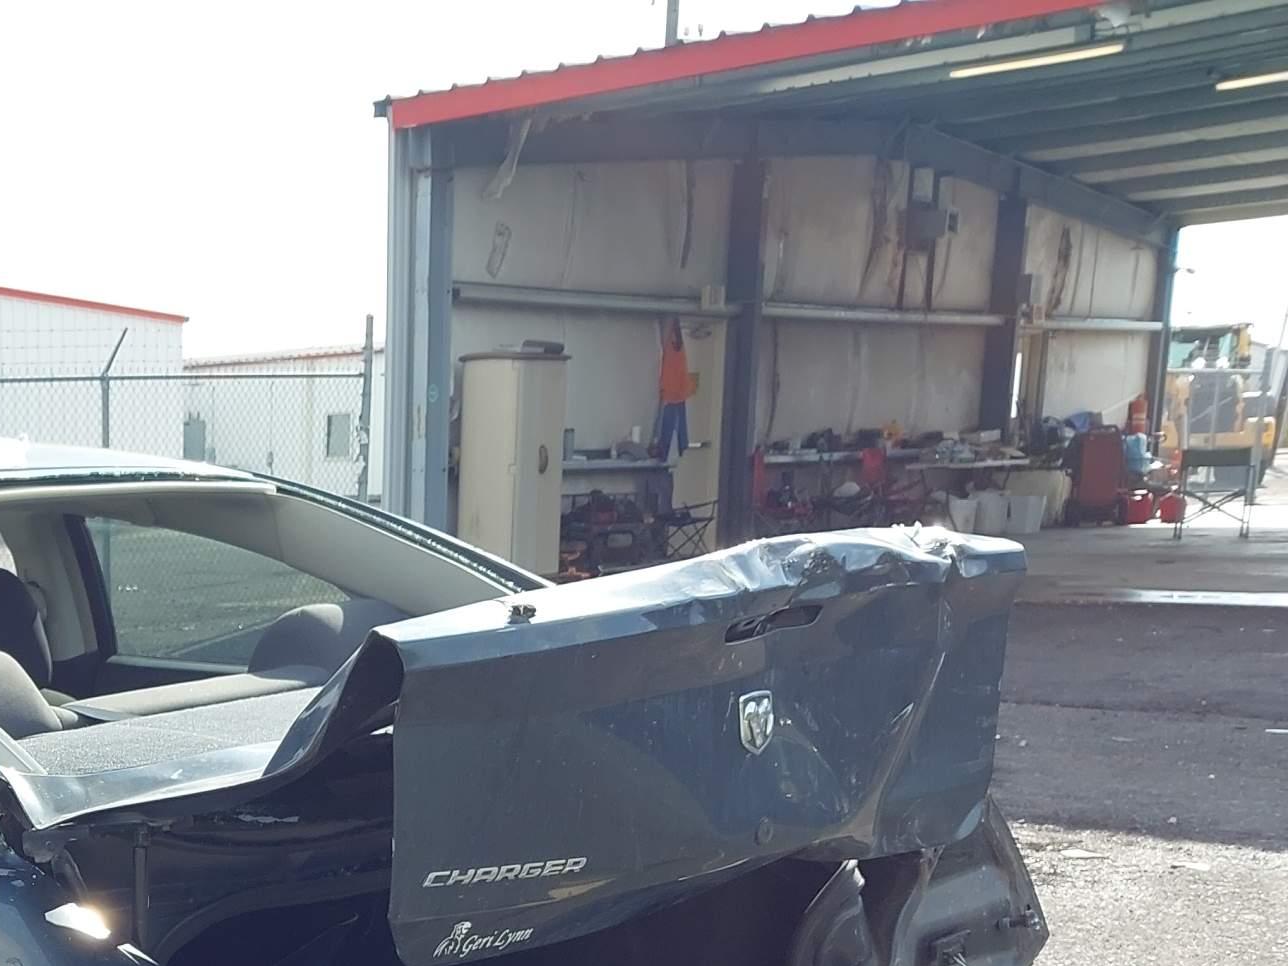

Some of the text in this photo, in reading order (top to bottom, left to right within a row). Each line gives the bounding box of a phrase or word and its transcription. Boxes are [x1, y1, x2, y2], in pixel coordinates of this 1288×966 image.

[422, 856, 587, 888] CHARGER
[459, 928, 534, 957] Geri Lynn
